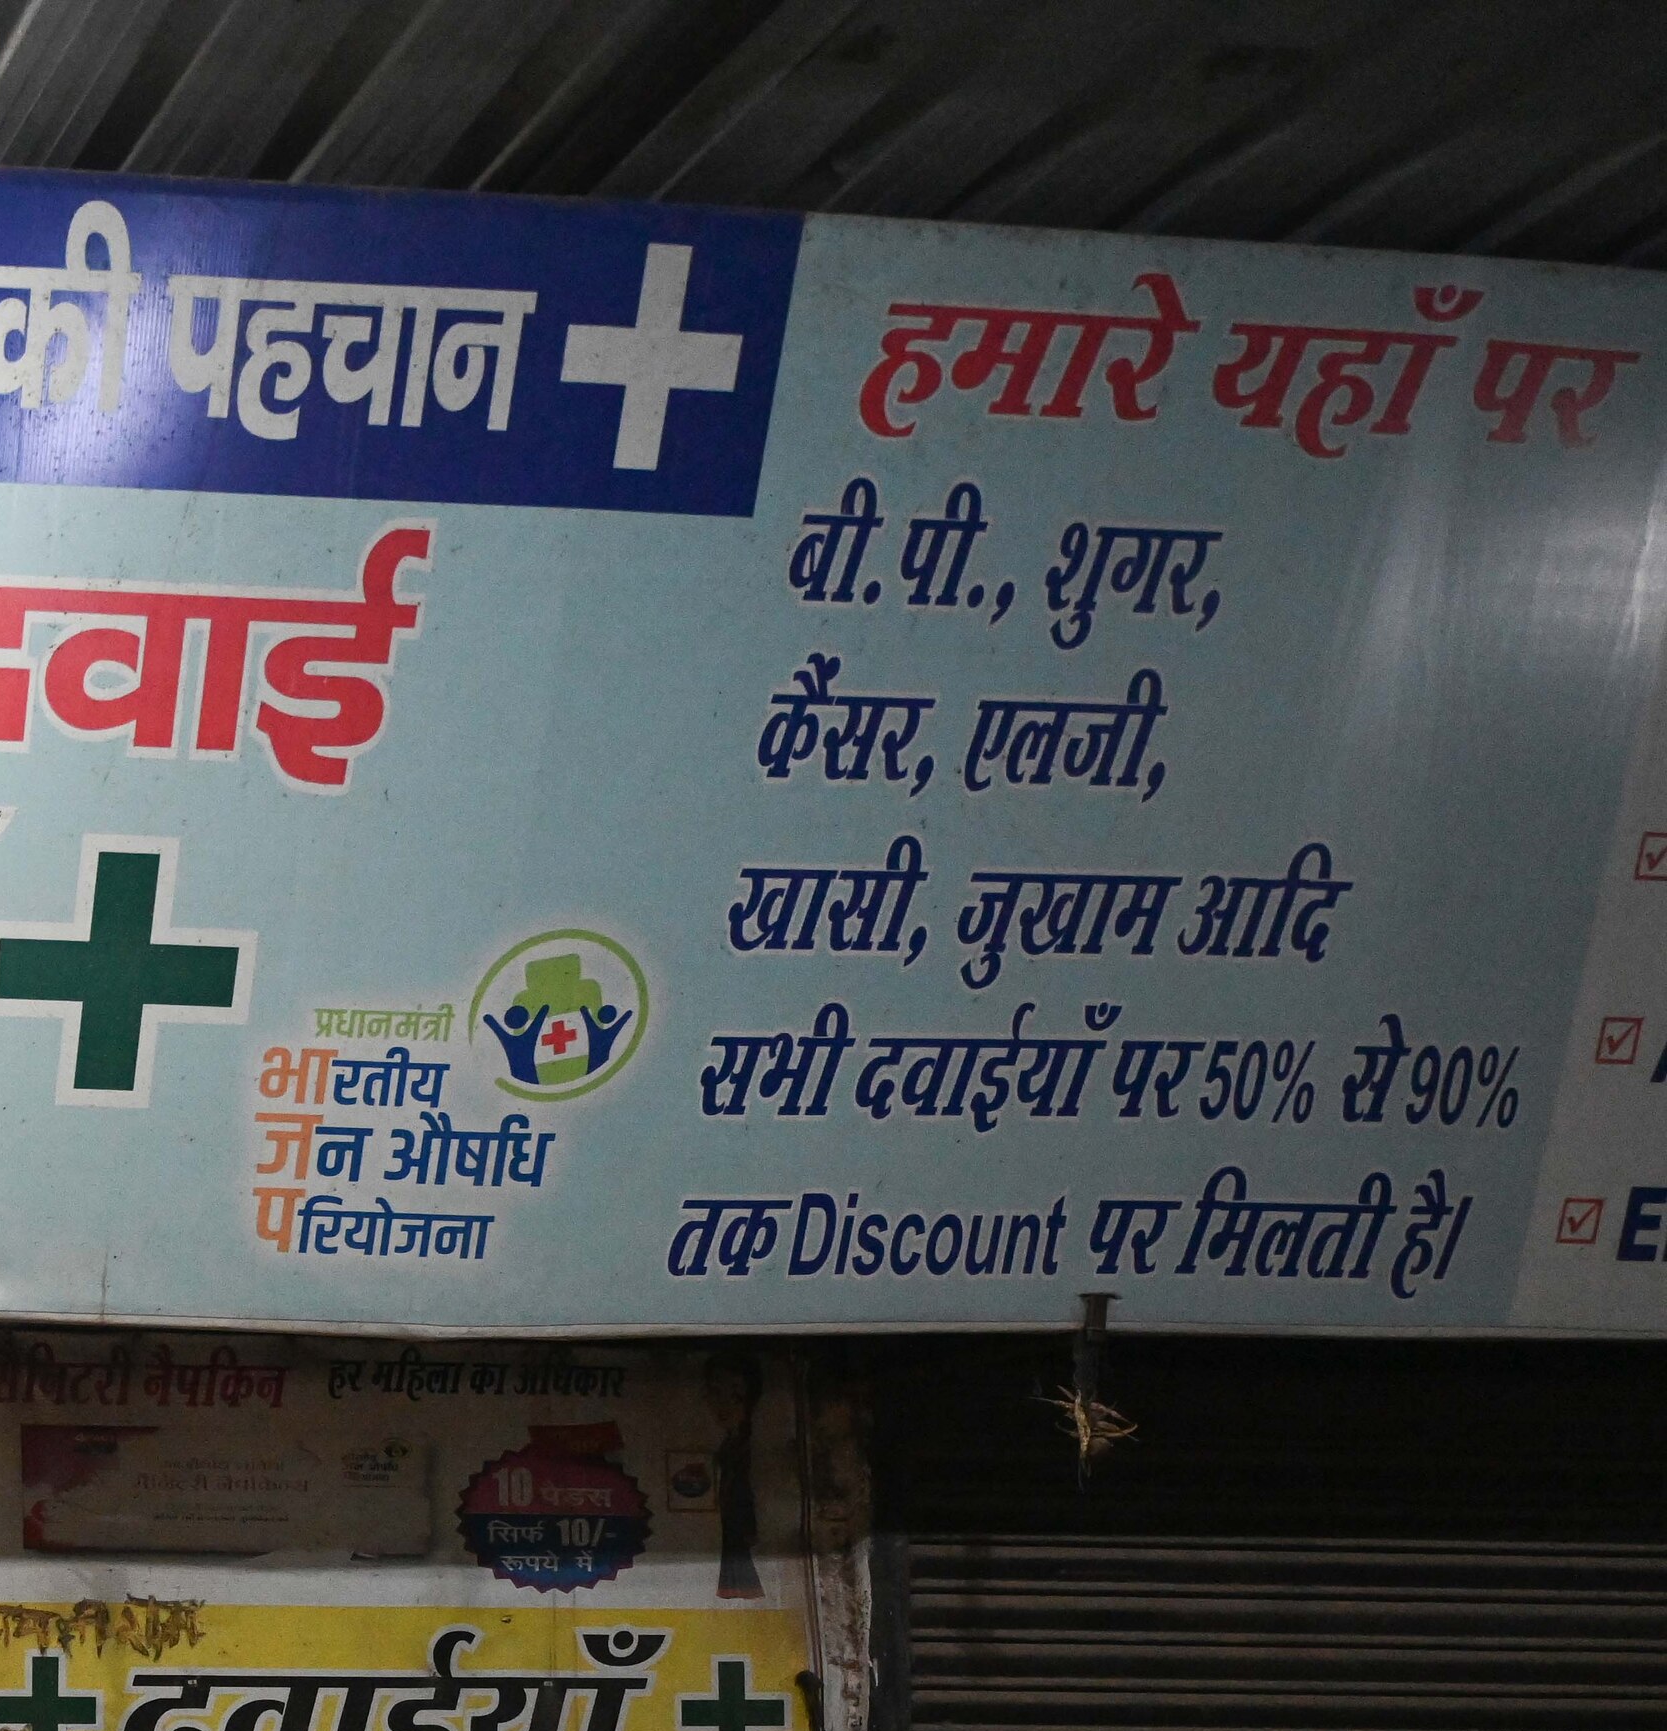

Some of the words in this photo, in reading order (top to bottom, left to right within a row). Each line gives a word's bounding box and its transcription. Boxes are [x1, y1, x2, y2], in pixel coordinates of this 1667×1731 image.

[165, 271, 537, 441] पहचान
[857, 273, 1198, 438] हमारे
[1211, 286, 1483, 458] यहाँ
[1472, 340, 1641, 446] पर
[1044, 520, 1222, 649] शुगर,
[964, 667, 1168, 803] एलजी,
[727, 834, 926, 966] खासी,
[958, 866, 1181, 989] जुखाम
[1177, 842, 1351, 962] आदि
[314, 1003, 455, 1042] प्रधानमंत्री
[698, 1003, 852, 1118] सभी
[856, 1003, 1121, 1132] दवाईयाँ
[1110, 1038, 1203, 1121] पर
[1199, 1038, 1314, 1125] 50%
[1342, 1014, 1405, 1126] से
[1406, 1042, 1522, 1130] 90%
[259, 1046, 450, 1108] भारतीय
[255, 1112, 373, 1182] जन
[384, 1111, 556, 1187] औषधि
[253, 1187, 495, 1260] परियोजना
[668, 1197, 795, 1278] तक
[788, 1192, 1066, 1277] Discount
[1088, 1197, 1182, 1276] पर
[1175, 1166, 1396, 1280] मिलती
[328, 1360, 362, 1399] हर
[373, 1357, 461, 1400] महिला
[470, 1363, 510, 1396] का
[487, 1518, 545, 1547] सिर्फ
[556, 1517, 617, 1547] 10/-
[492, 1467, 531, 1508] 10
